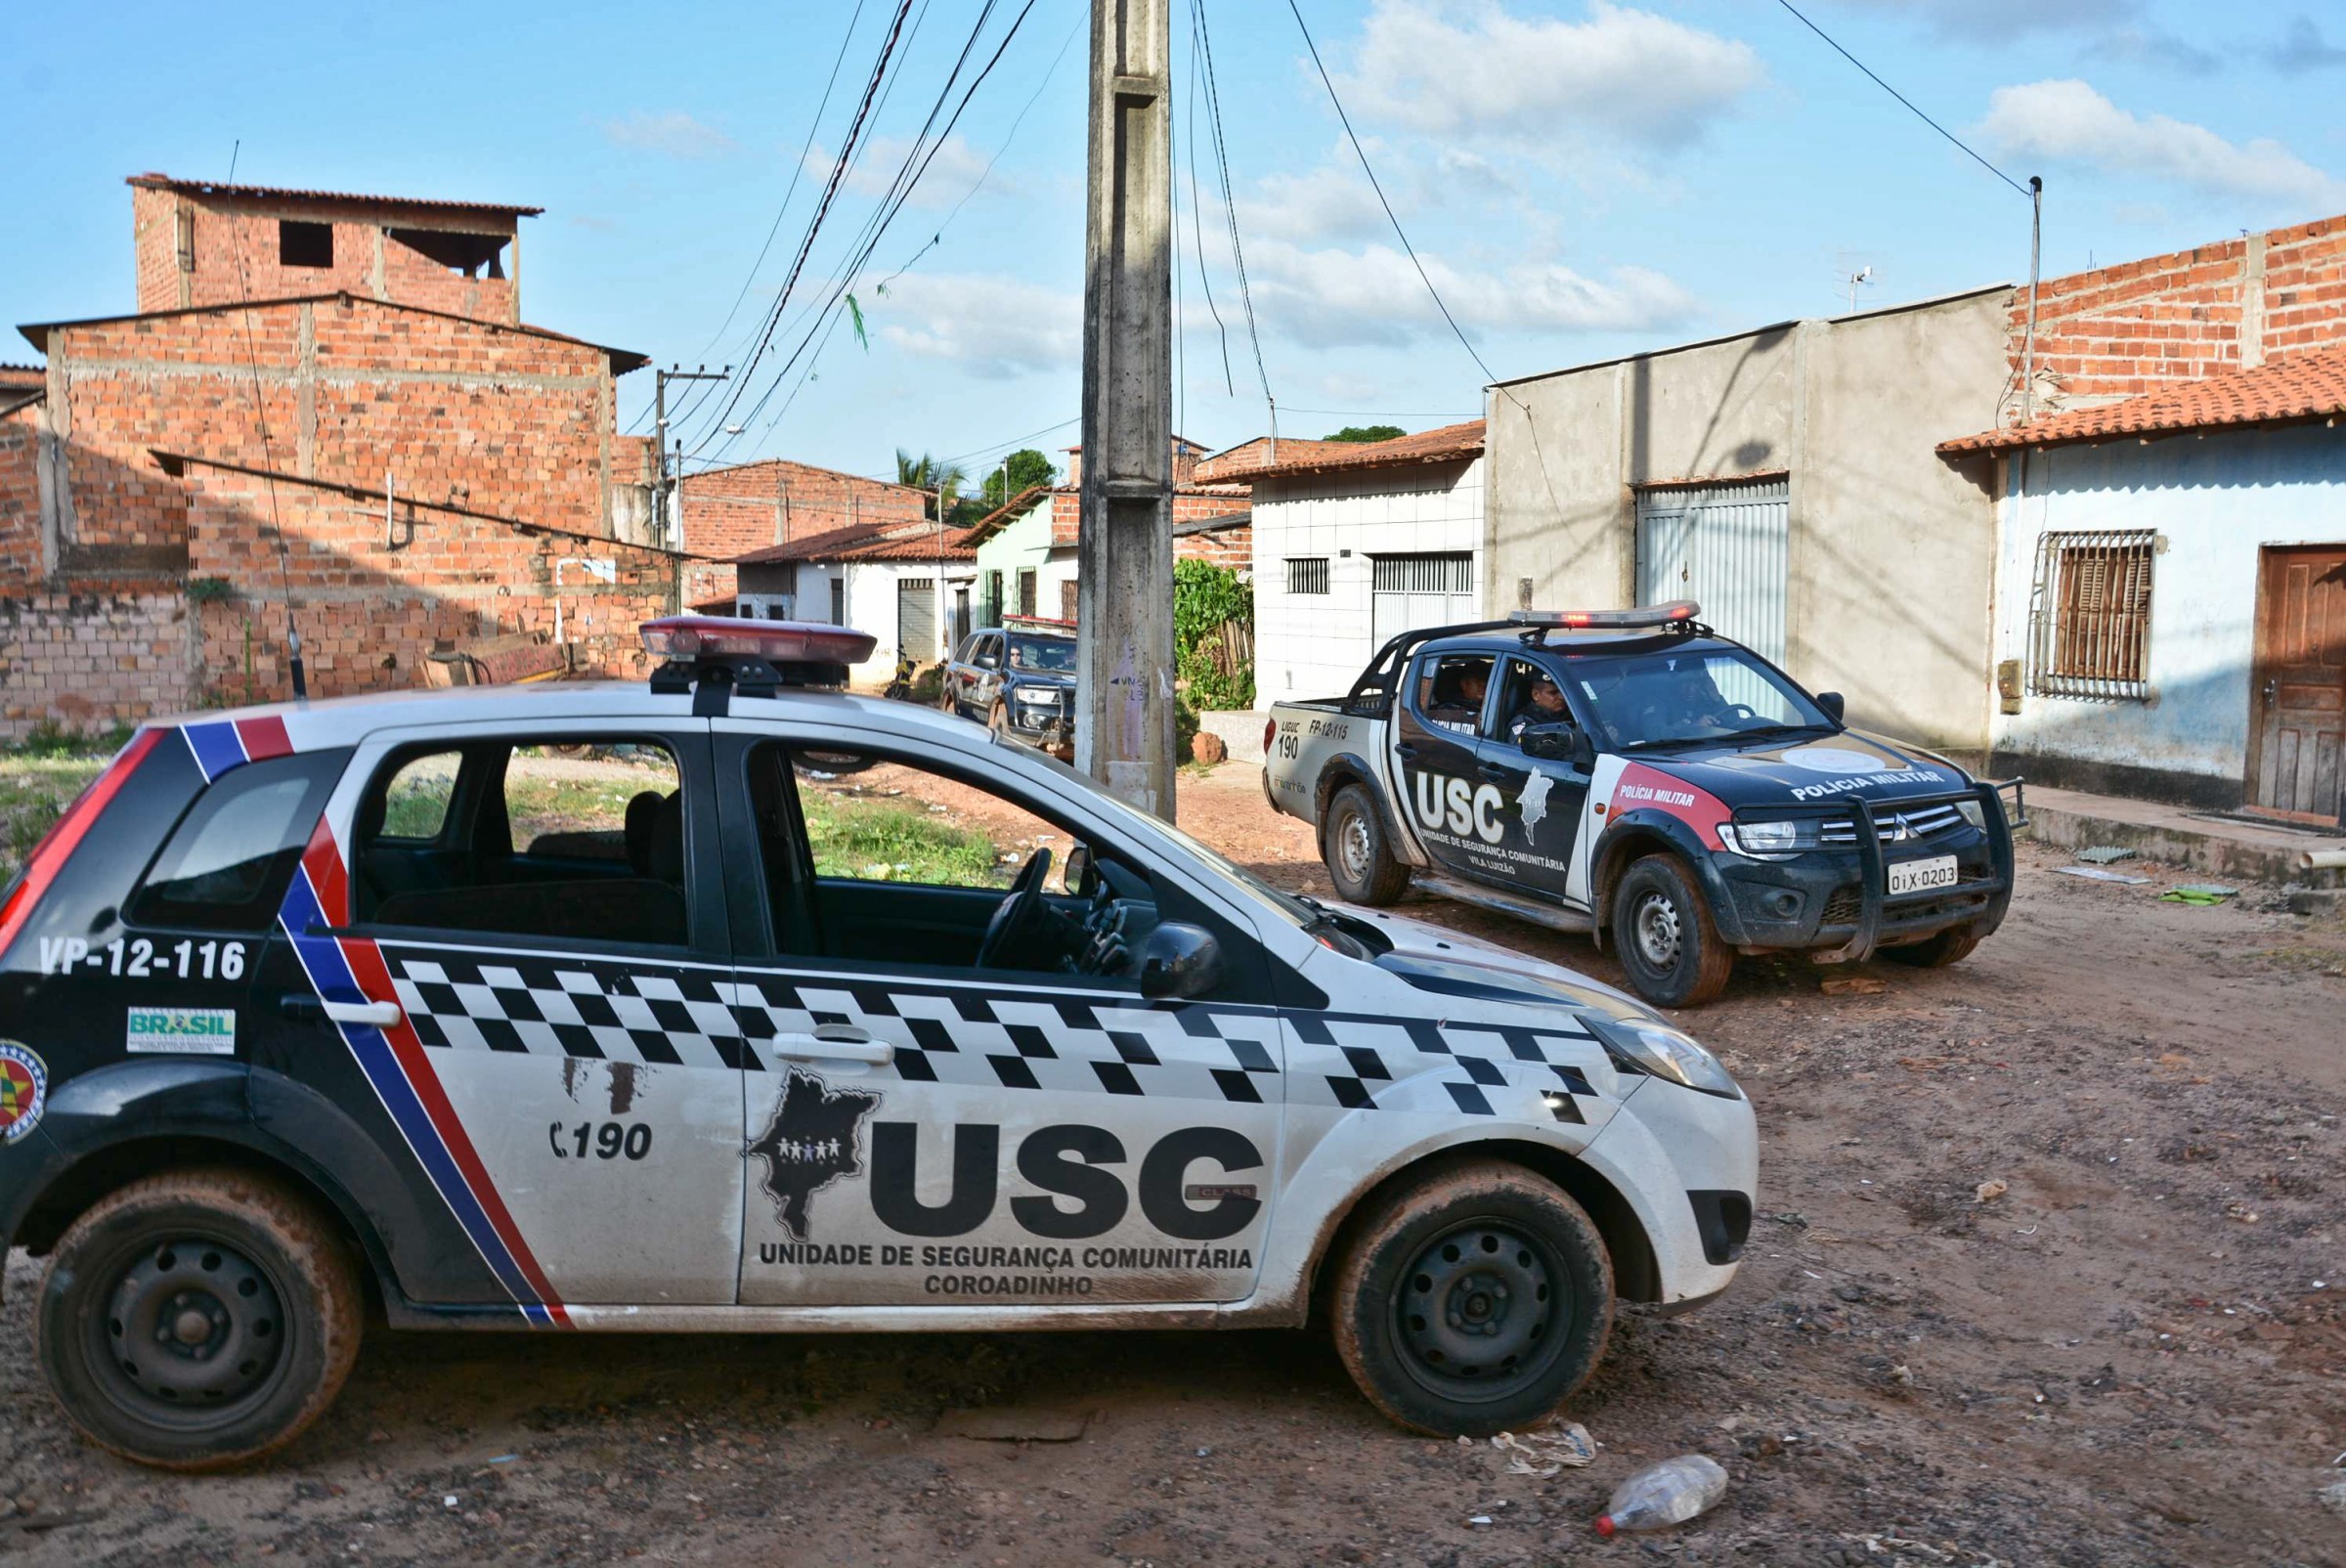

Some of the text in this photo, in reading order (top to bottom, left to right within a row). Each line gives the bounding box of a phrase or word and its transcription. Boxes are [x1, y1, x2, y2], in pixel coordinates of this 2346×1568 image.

[1309, 719, 1349, 740] FP-12-115
[1451, 721, 1476, 736] MILITAR
[1279, 734, 1299, 760] 190
[1620, 784, 1696, 807] POLÍCIA MILITAR
[1791, 769, 1945, 802] POLÍCIA MILITAR
[1416, 770, 1504, 845] USC
[1419, 828, 1567, 872] UNIDADE DE SEGURANÇA COMUNITÁRIA
[1468, 854, 1516, 875] VILA LUIZÃO
[39, 936, 246, 980] VP-12-116
[129, 1014, 233, 1036] BRASIL
[573, 1121, 652, 1161] 190
[869, 1120, 1265, 1241] USC
[760, 1242, 1254, 1274] UNIDADE DE SEGURANÇA COMUNITÁRIA
[924, 1275, 1094, 1295] COROADINHO
